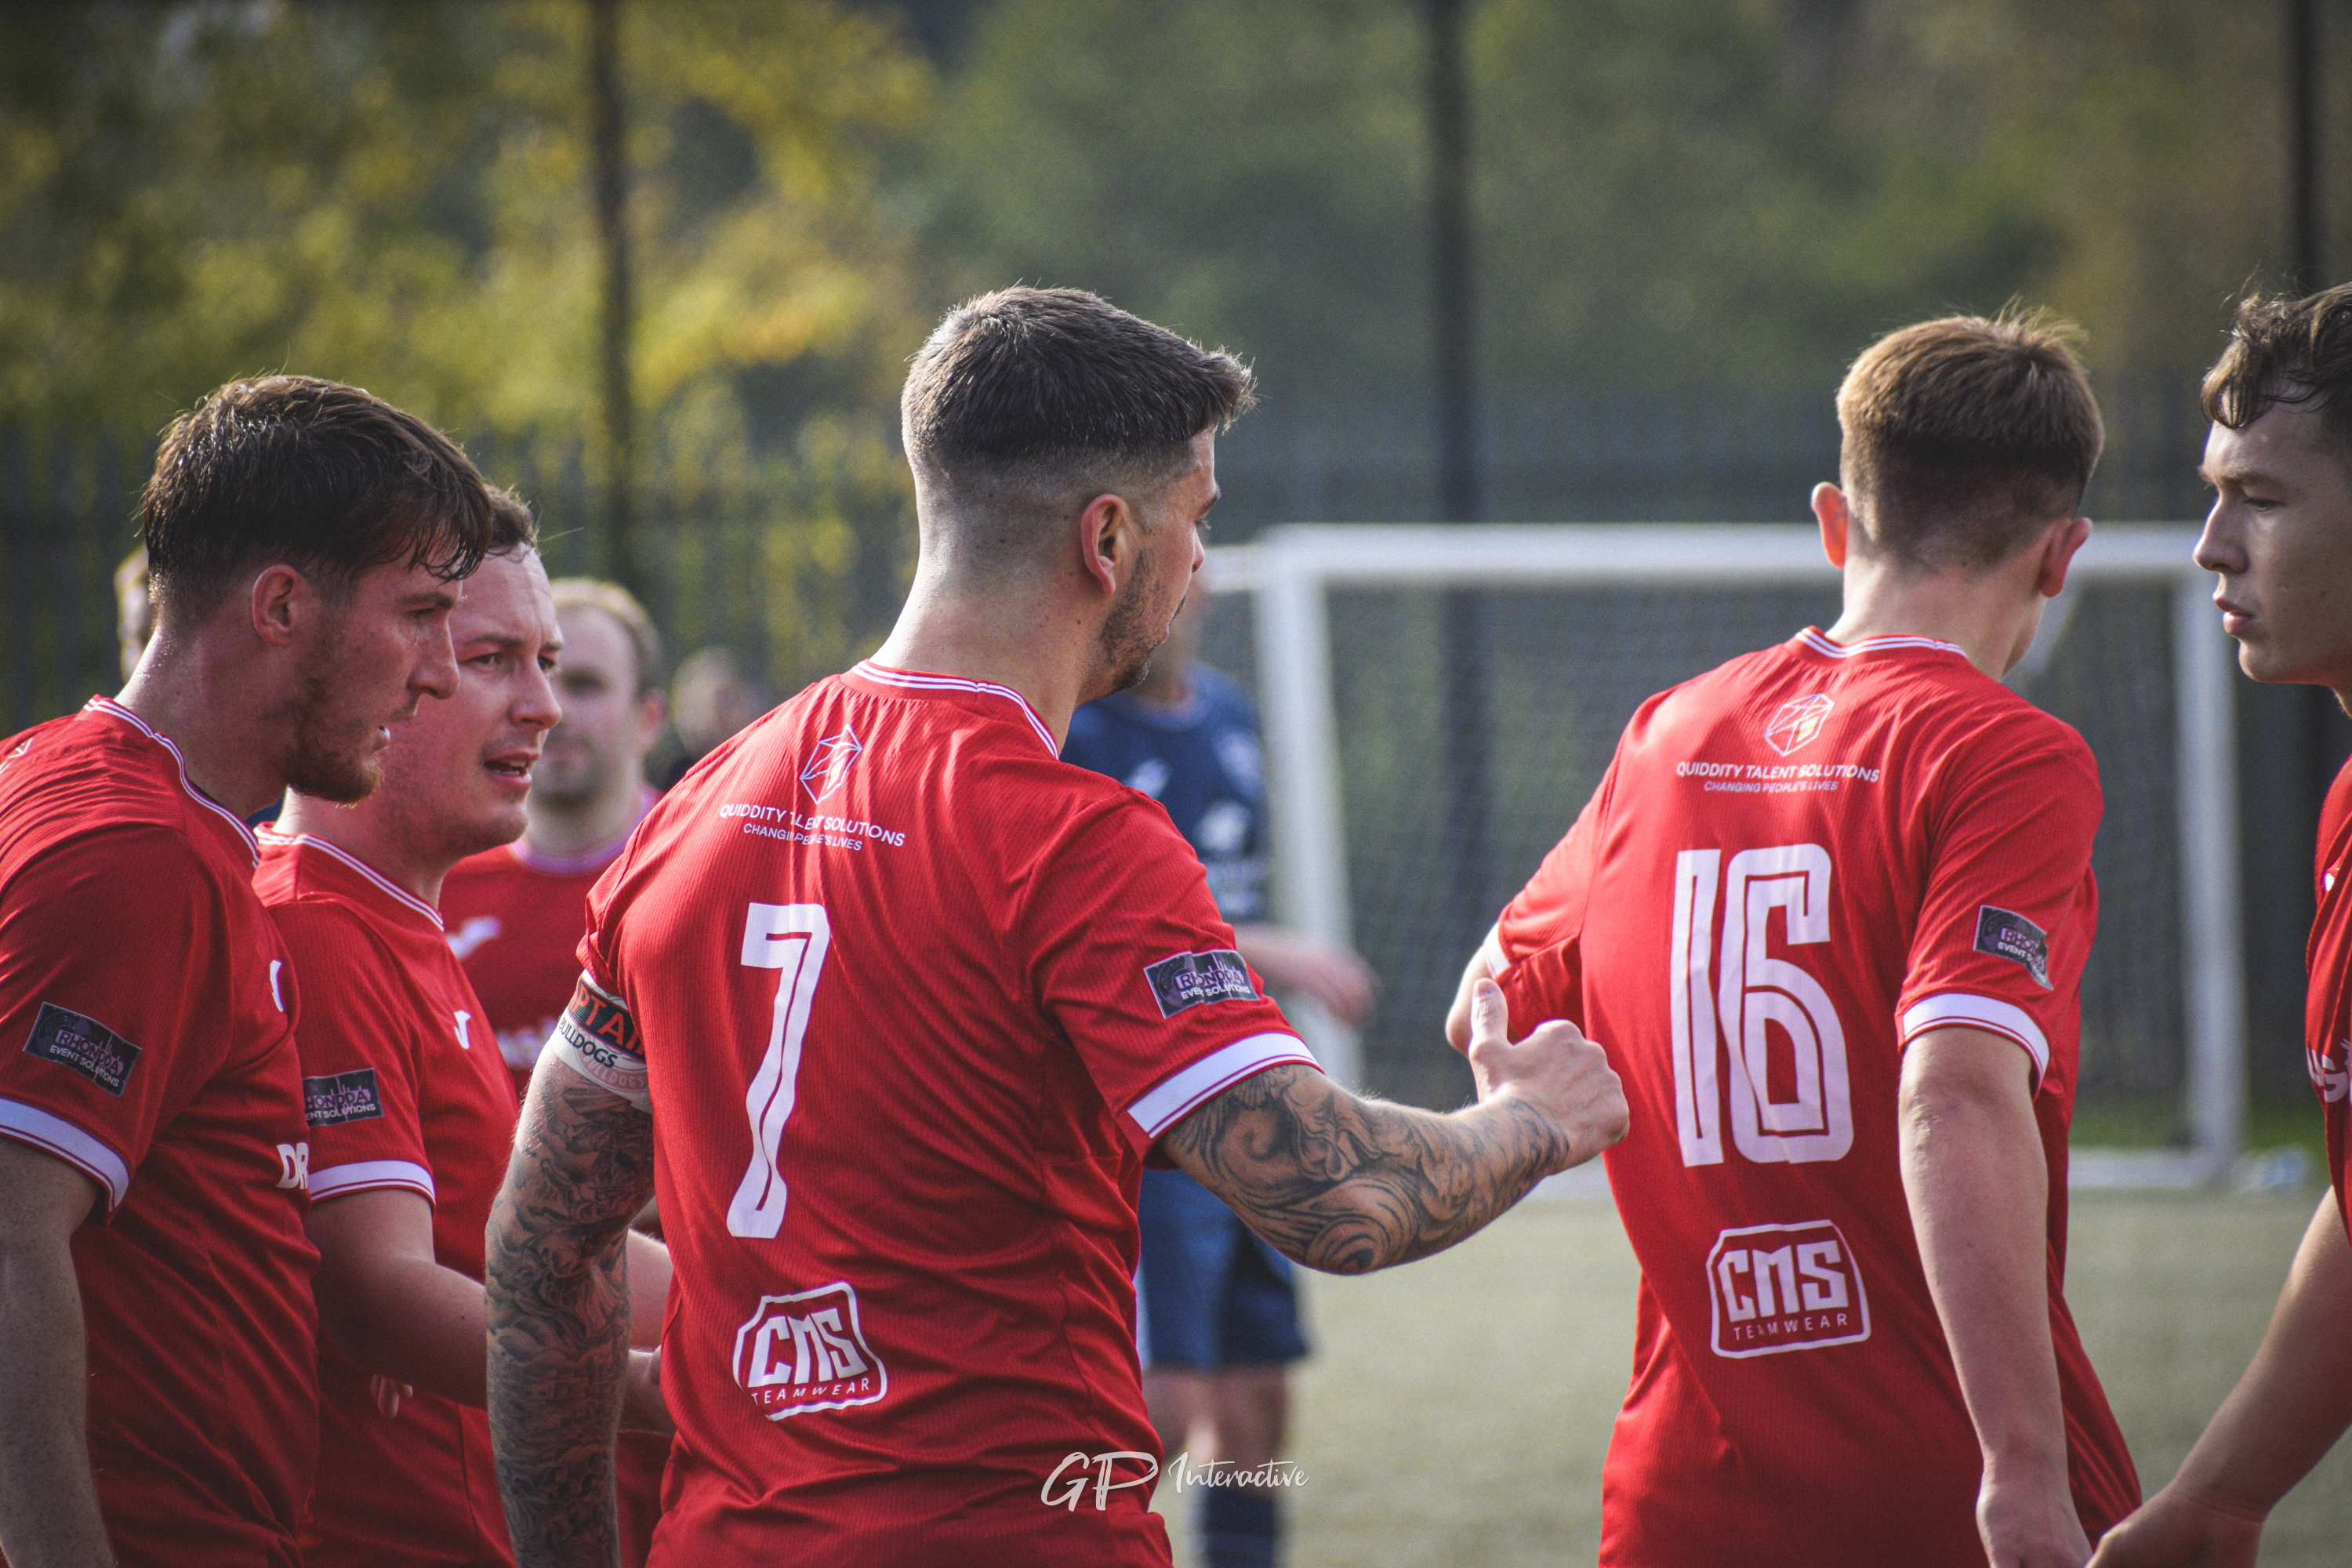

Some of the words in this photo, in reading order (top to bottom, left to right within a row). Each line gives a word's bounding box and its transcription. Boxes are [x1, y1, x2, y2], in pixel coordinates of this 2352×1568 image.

[1676, 761, 1744, 778] QUIDDITY
[1745, 764, 1798, 780] TALENT
[1798, 763, 1881, 783] SOLUTIONS
[1704, 780, 1761, 793] CHANGING
[1762, 781, 1807, 793] PEOPLE'S
[1807, 780, 1839, 791] LIVES
[719, 803, 787, 823] QUIDDITY
[789, 811, 825, 831] TLENT
[823, 815, 906, 847] SOLUTIONS
[743, 823, 793, 841] CHANGI
[832, 836, 862, 851] LIVES
[1998, 941, 2027, 959] EVENT
[1206, 982, 1251, 997] SOLUTIONS
[1670, 843, 1855, 1168] 16
[57, 1030, 122, 1076] RHONDDA
[558, 1017, 618, 1068] BULLDOGS
[49, 1044, 80, 1062] EVENT
[79, 1056, 120, 1087] SOLUTIONS
[726, 902, 831, 1239] 7
[304, 1090, 369, 1110] HONDDA
[324, 1103, 376, 1120] SOLUTIONS
[1717, 1240, 1849, 1323] CMS
[1733, 1313, 1849, 1341] TEAMWEAR
[747, 1308, 869, 1388] CMS
[751, 1377, 869, 1406] TEAMWEAR
